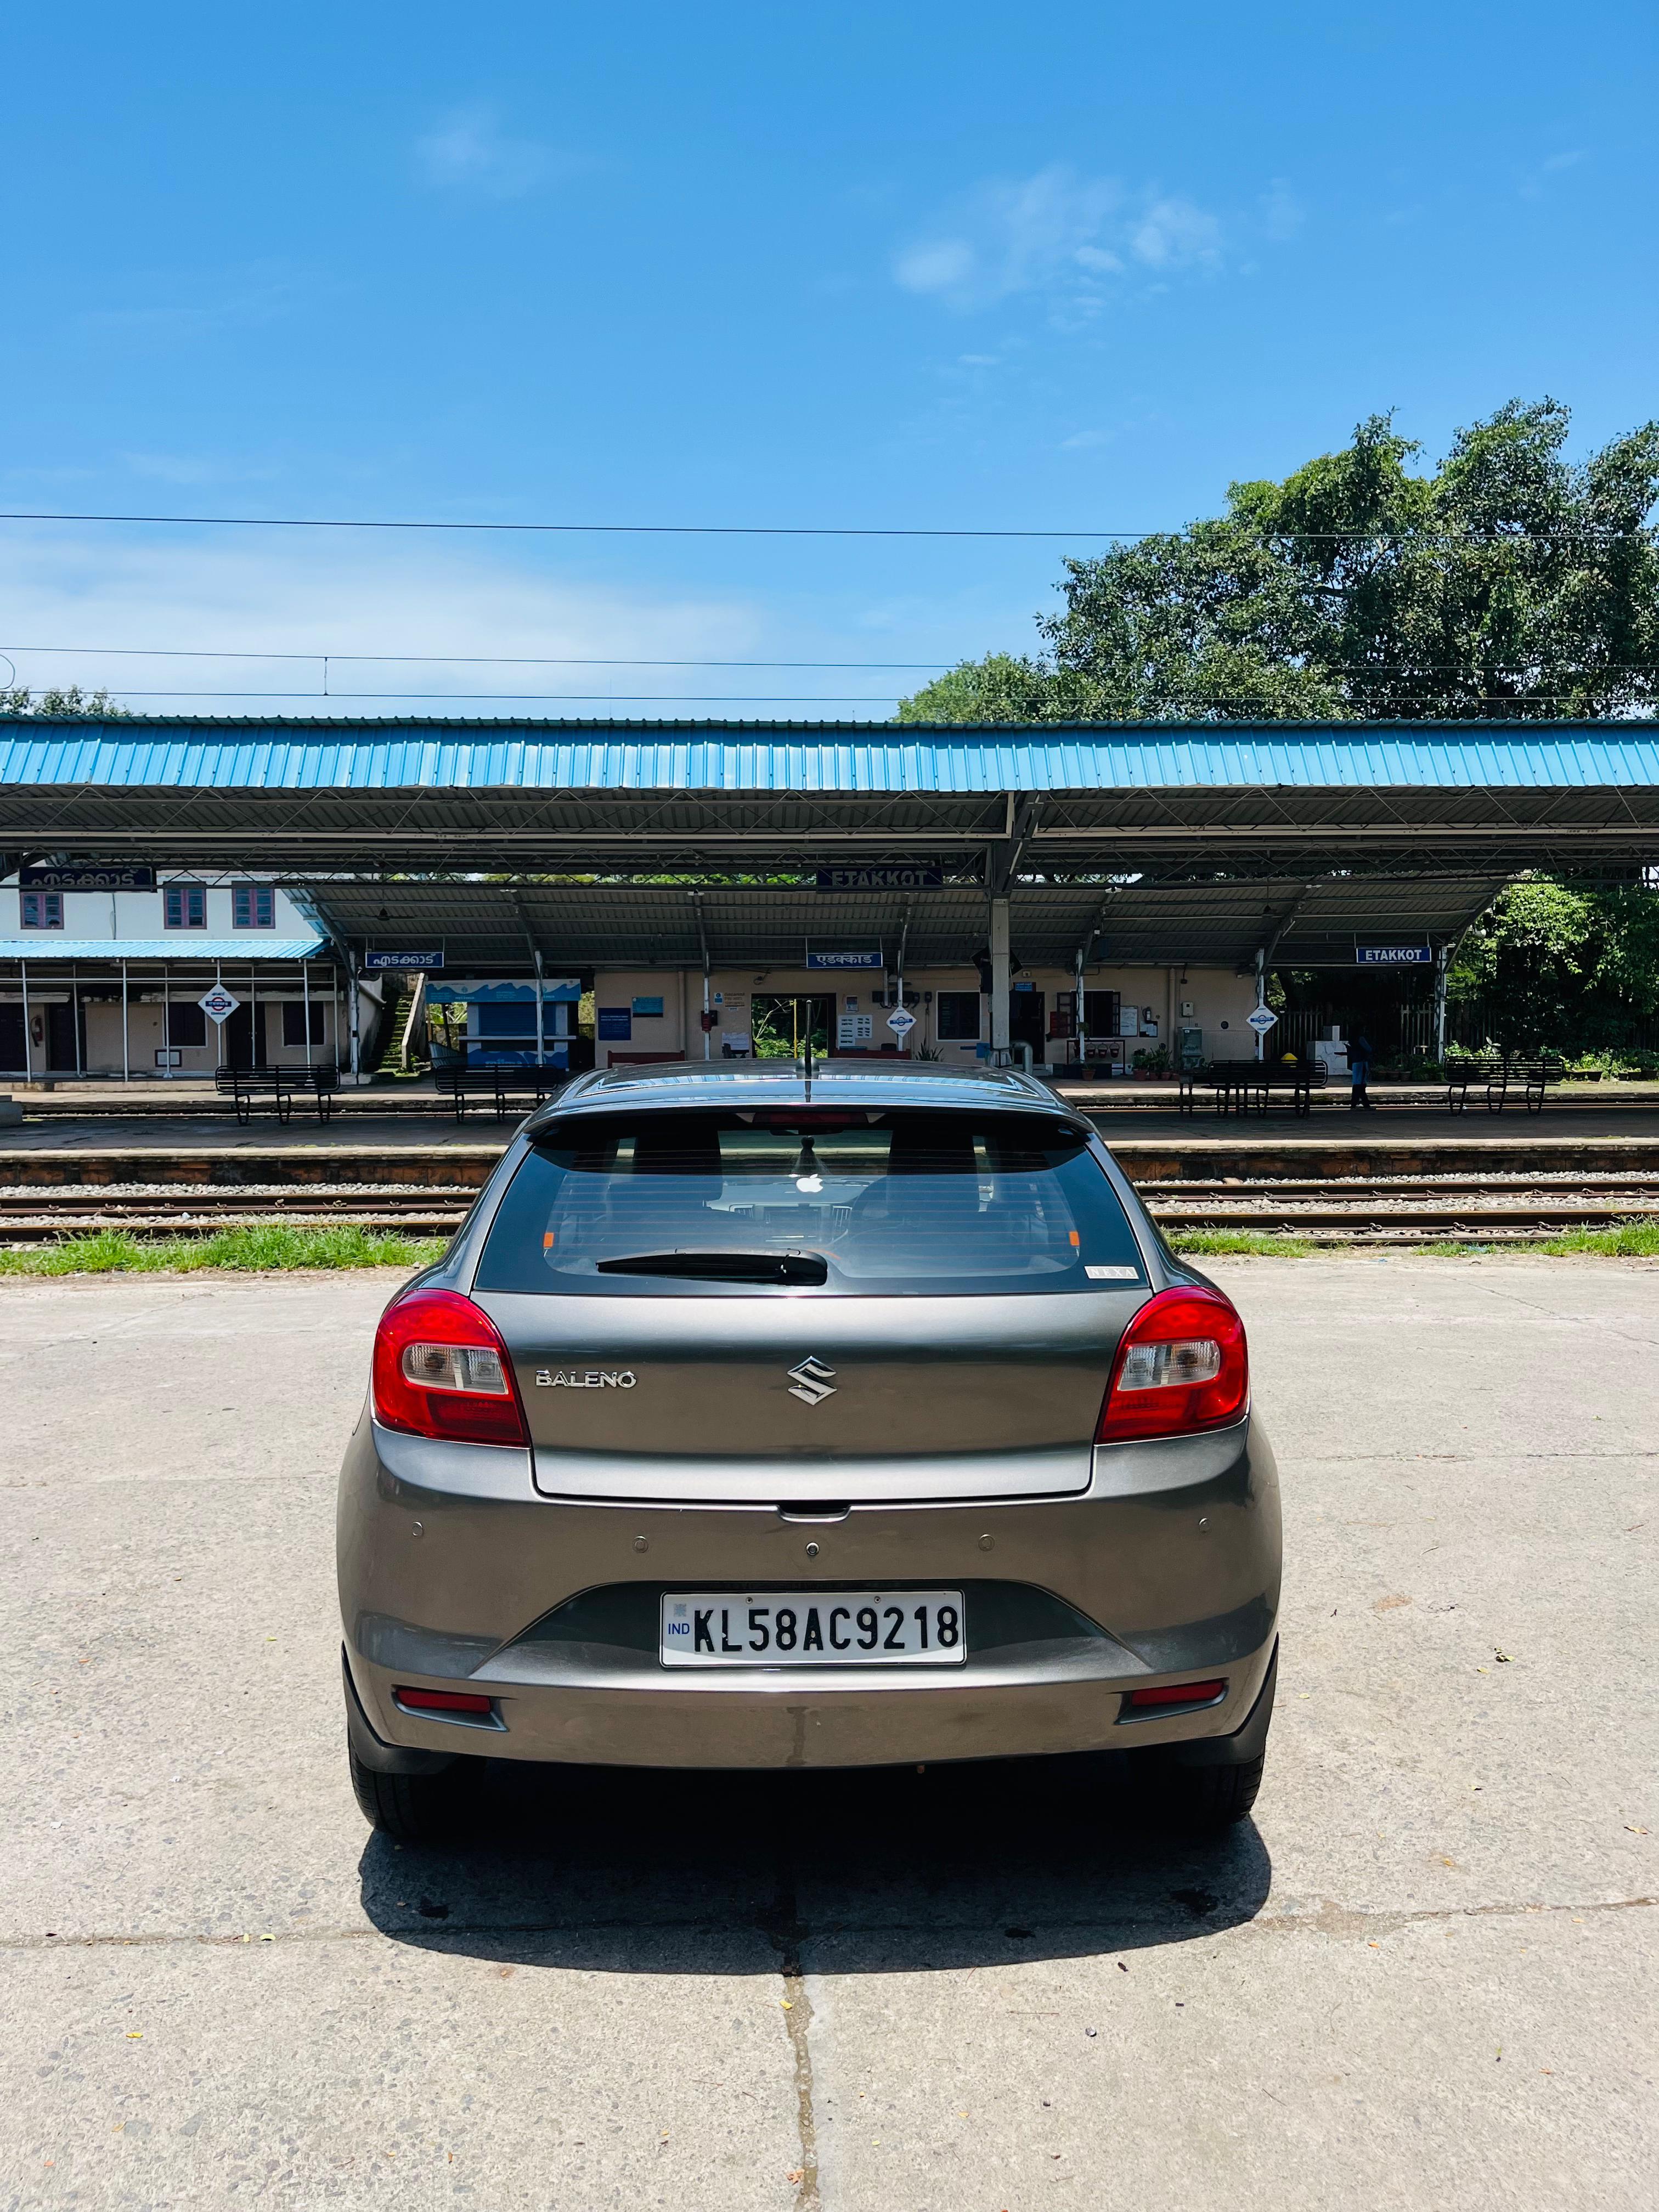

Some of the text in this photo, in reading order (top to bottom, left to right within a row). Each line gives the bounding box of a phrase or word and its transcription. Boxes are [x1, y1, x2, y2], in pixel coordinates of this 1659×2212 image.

[832, 871, 928, 886] ETAKKOT
[373, 953, 436, 967] എടക്കാട്
[815, 955, 873, 966] एडक्काड
[1365, 950, 1422, 961] ETAKKOT
[1090, 1268, 1135, 1277] NEXA
[536, 1370, 637, 1388] BALENO
[668, 1623, 690, 1635] IND
[694, 1606, 958, 1652] KL58AC9218
